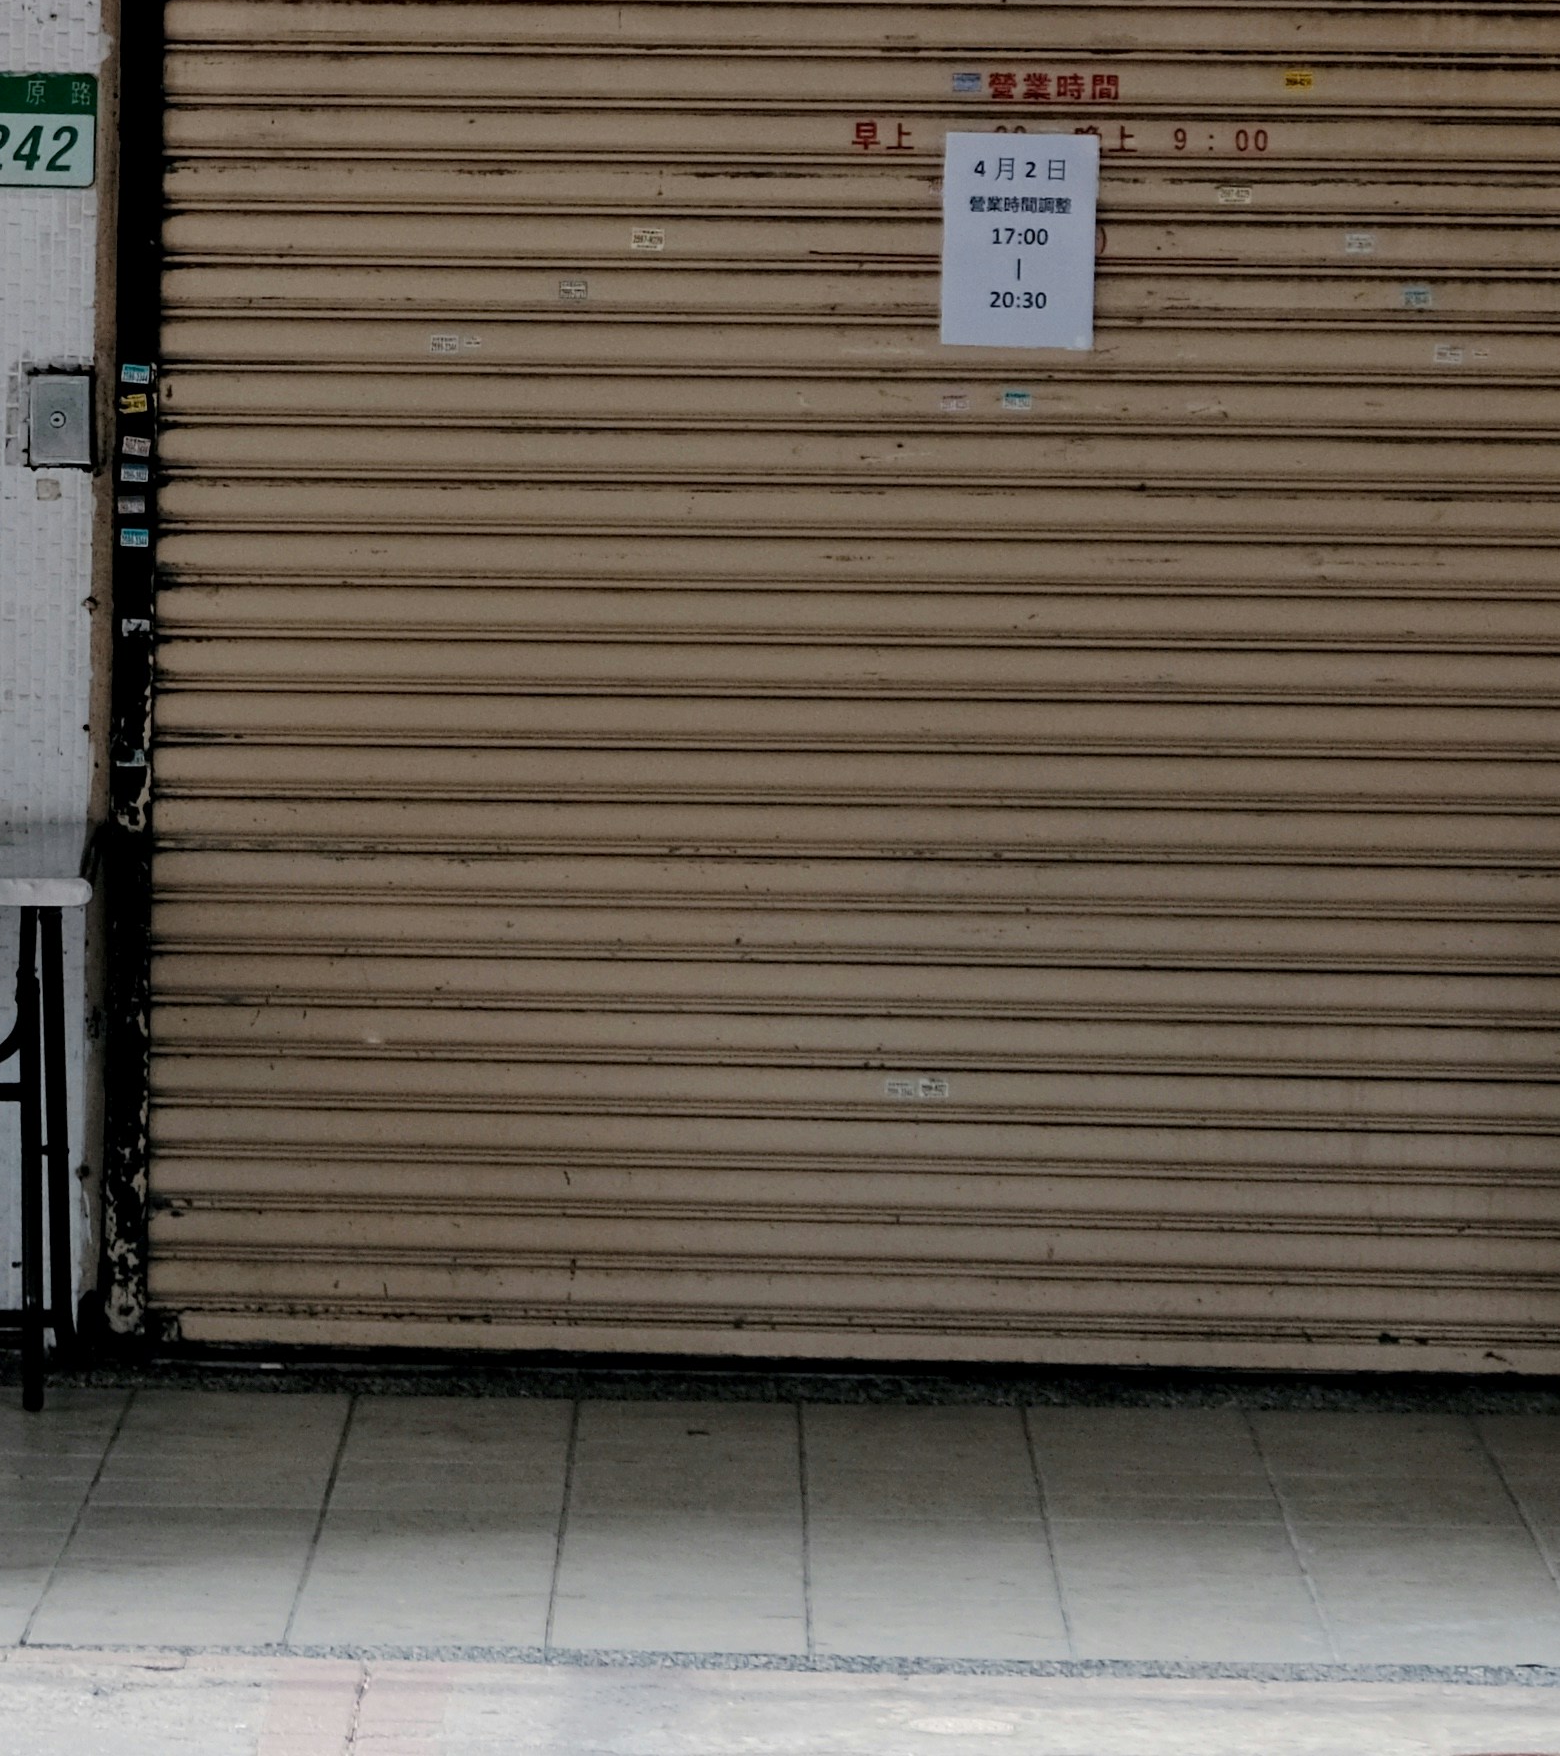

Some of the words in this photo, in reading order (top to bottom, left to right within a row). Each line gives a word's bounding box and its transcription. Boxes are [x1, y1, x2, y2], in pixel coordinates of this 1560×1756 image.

[988, 73, 1120, 101] 營業時間
[852, 121, 916, 151] 早上
[969, 196, 1072, 214] 營業時間調整
[991, 227, 1049, 247] 17:00
[989, 290, 1048, 309] 20:30
